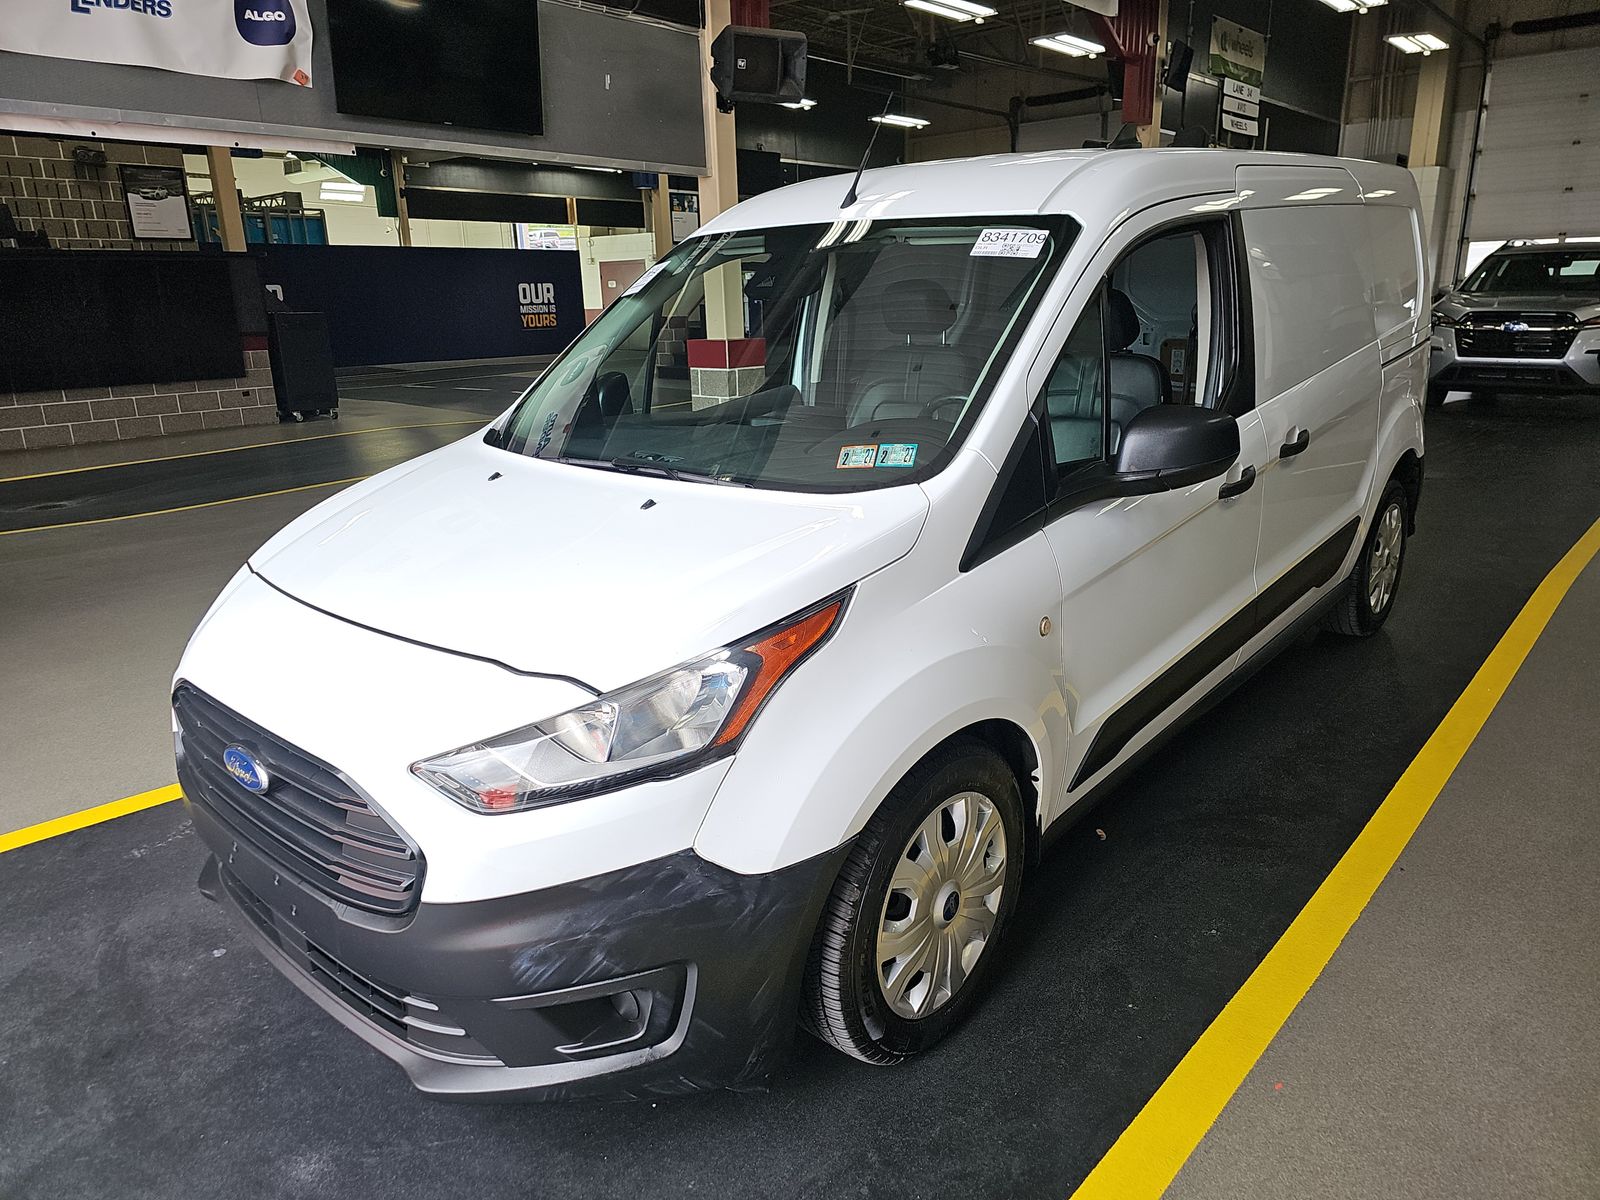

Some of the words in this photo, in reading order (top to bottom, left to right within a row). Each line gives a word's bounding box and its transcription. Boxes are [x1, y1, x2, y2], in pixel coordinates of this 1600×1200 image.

[244, 9, 286, 21] ALGO
[1232, 82, 1244, 96] LANE
[1230, 119, 1248, 132] WHEELS
[981, 231, 1047, 244] 8341709
[518, 283, 555, 304] OUR
[520, 305, 548, 313] MISSION
[549, 304, 556, 312] IS
[521, 314, 557, 327] YOURS
[842, 452, 849, 465] 2
[864, 448, 875, 464] 27
[880, 450, 888, 463] 2
[903, 447, 914, 463] 27
[229, 754, 258, 784] Ford
